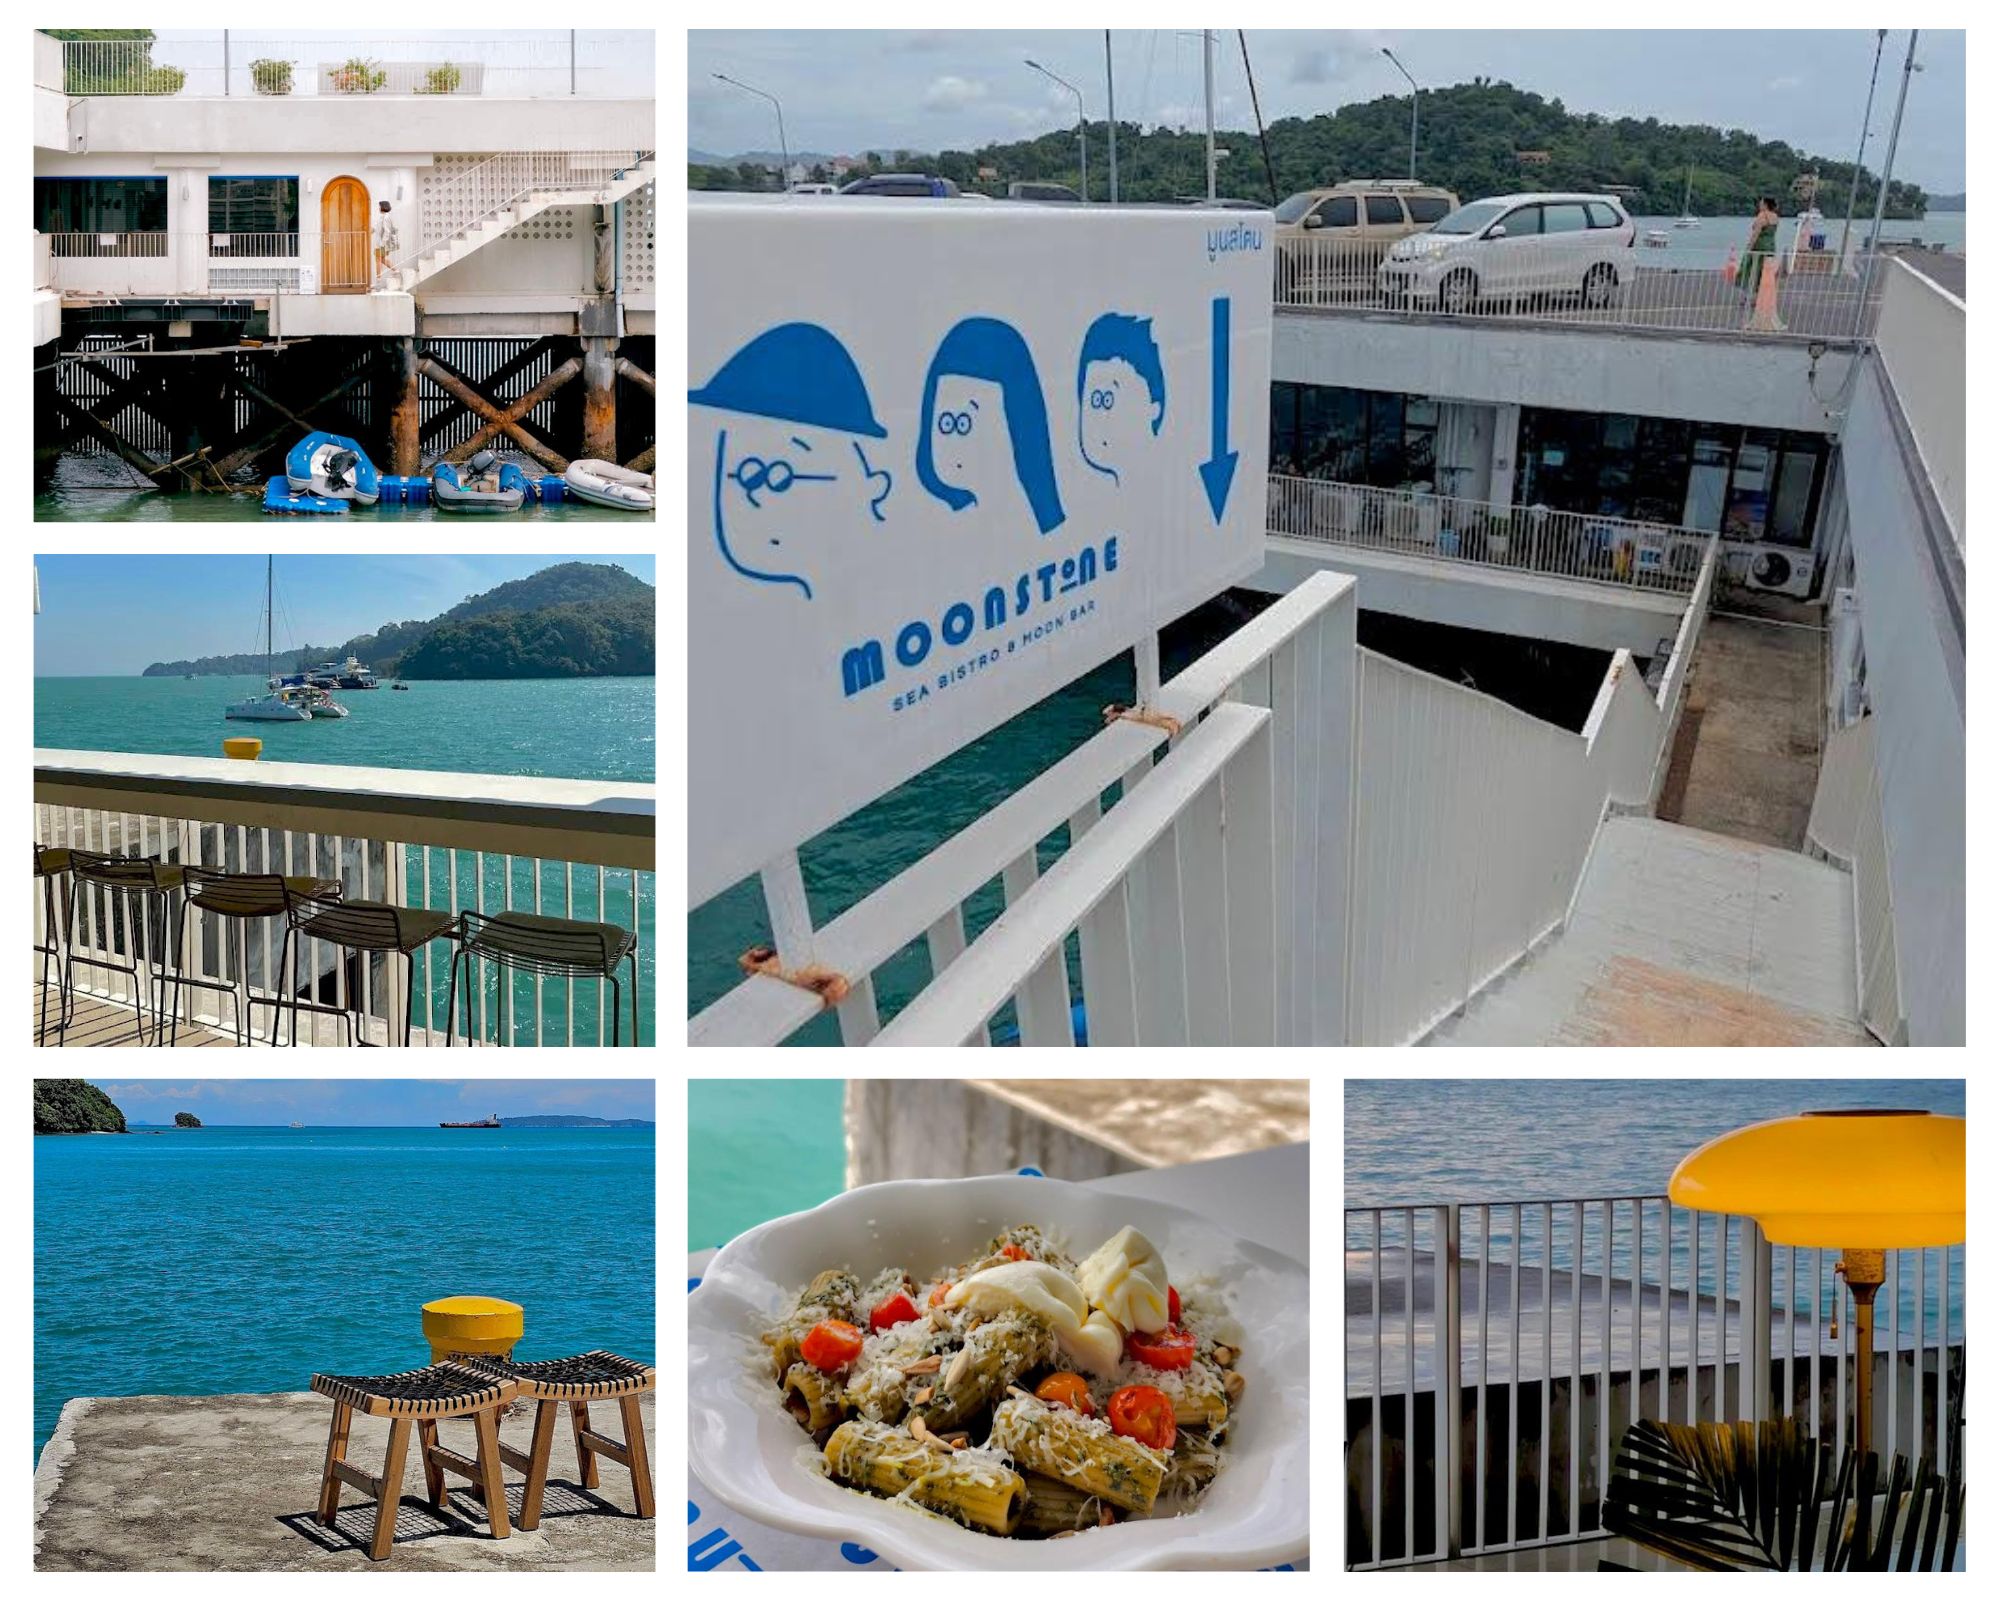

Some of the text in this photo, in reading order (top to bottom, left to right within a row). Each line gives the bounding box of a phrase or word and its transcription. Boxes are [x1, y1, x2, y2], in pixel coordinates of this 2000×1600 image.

[842, 536, 1117, 696] MOONSTONE
[893, 684, 930, 711] SEA
[937, 650, 1000, 689] BISTRO
[1022, 617, 1064, 646] MOON
[1070, 600, 1095, 620] BAR
